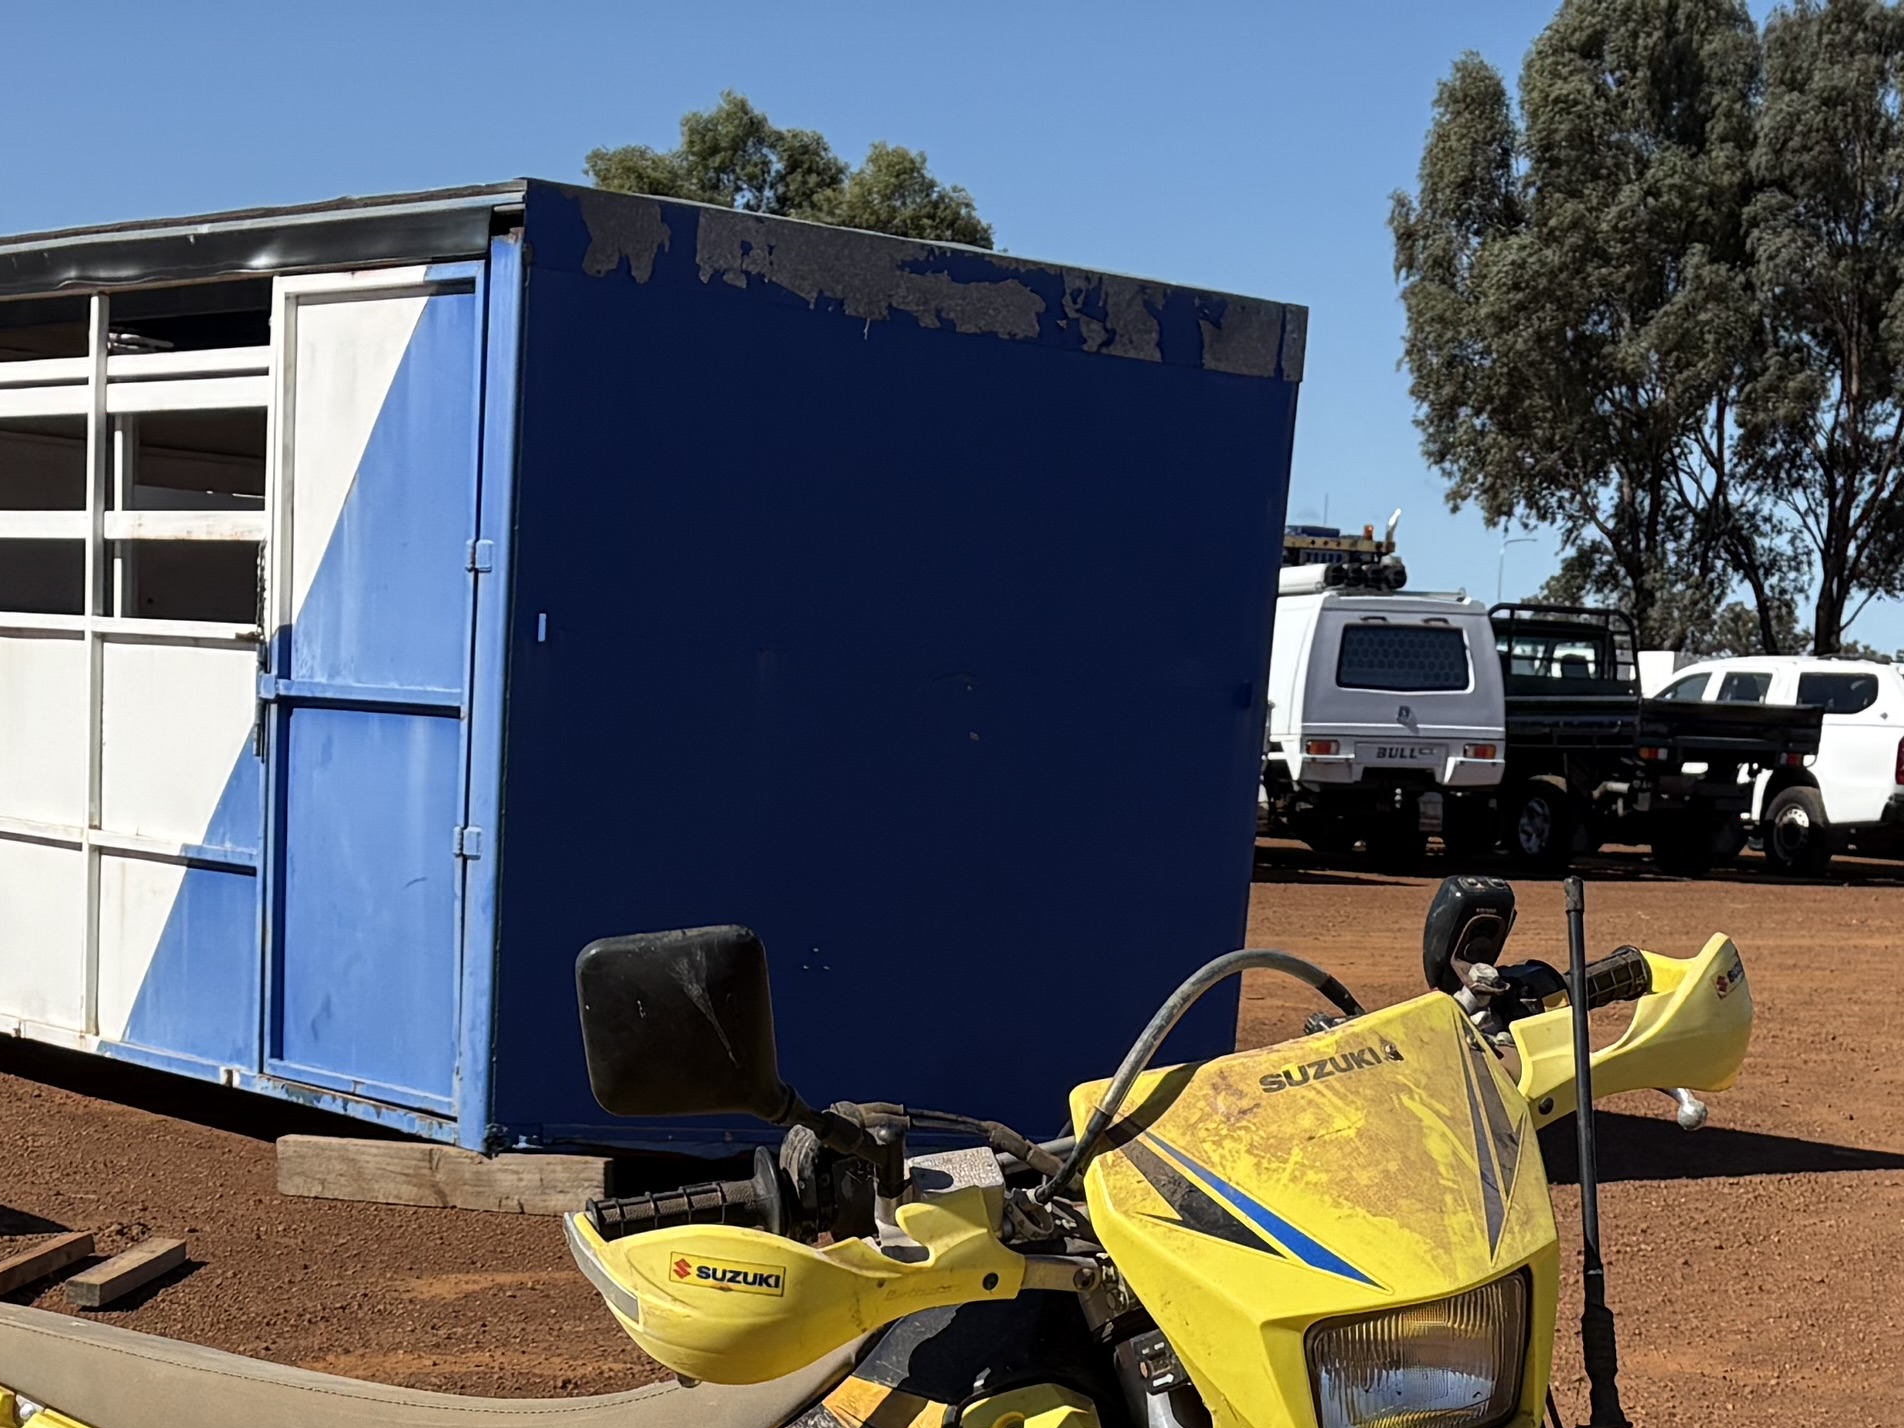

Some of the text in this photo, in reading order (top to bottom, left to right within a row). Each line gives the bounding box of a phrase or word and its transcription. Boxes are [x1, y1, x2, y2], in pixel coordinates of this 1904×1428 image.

[1376, 746, 1418, 760] BULL
[1259, 1046, 1383, 1094] SUZUKI
[696, 1265, 781, 1289] SUZUKI
